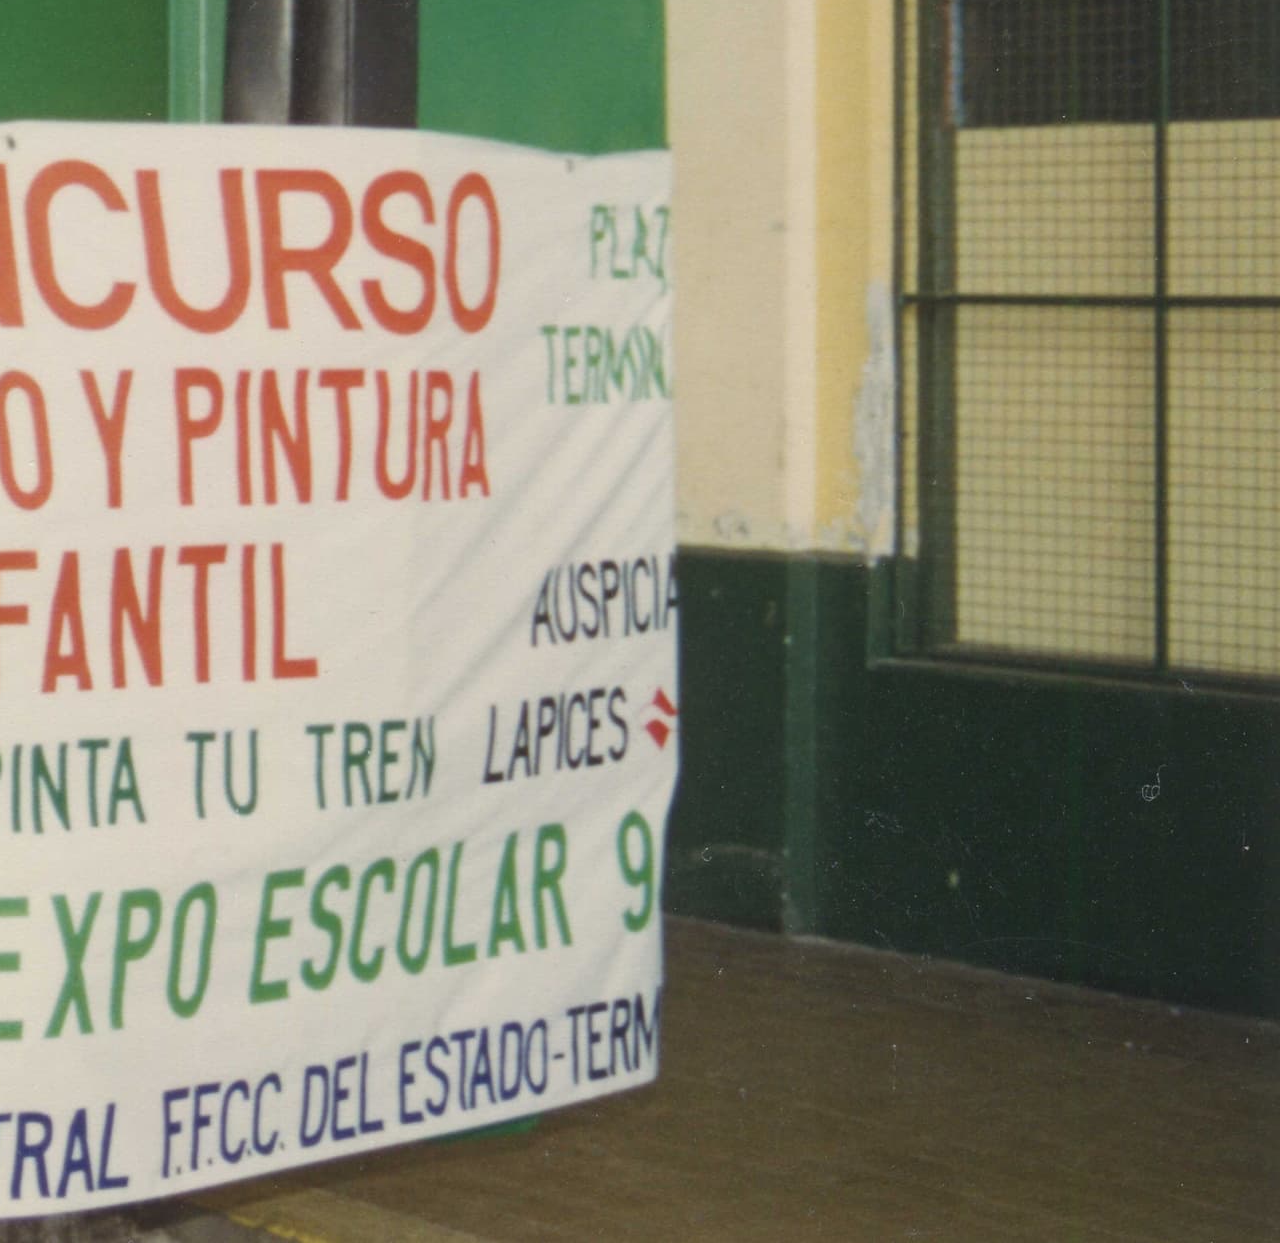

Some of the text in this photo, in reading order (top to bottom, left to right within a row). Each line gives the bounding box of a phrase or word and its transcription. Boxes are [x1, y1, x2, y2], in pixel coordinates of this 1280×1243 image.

[81, 368, 134, 509] Y
[174, 367, 491, 507] PINTURA
[185, 729, 259, 816] TU
[305, 716, 436, 810] TREN
[481, 686, 629, 785] LAPICES
[248, 821, 574, 1005] ESCOLAR
[299, 1051, 385, 1149] DEL
